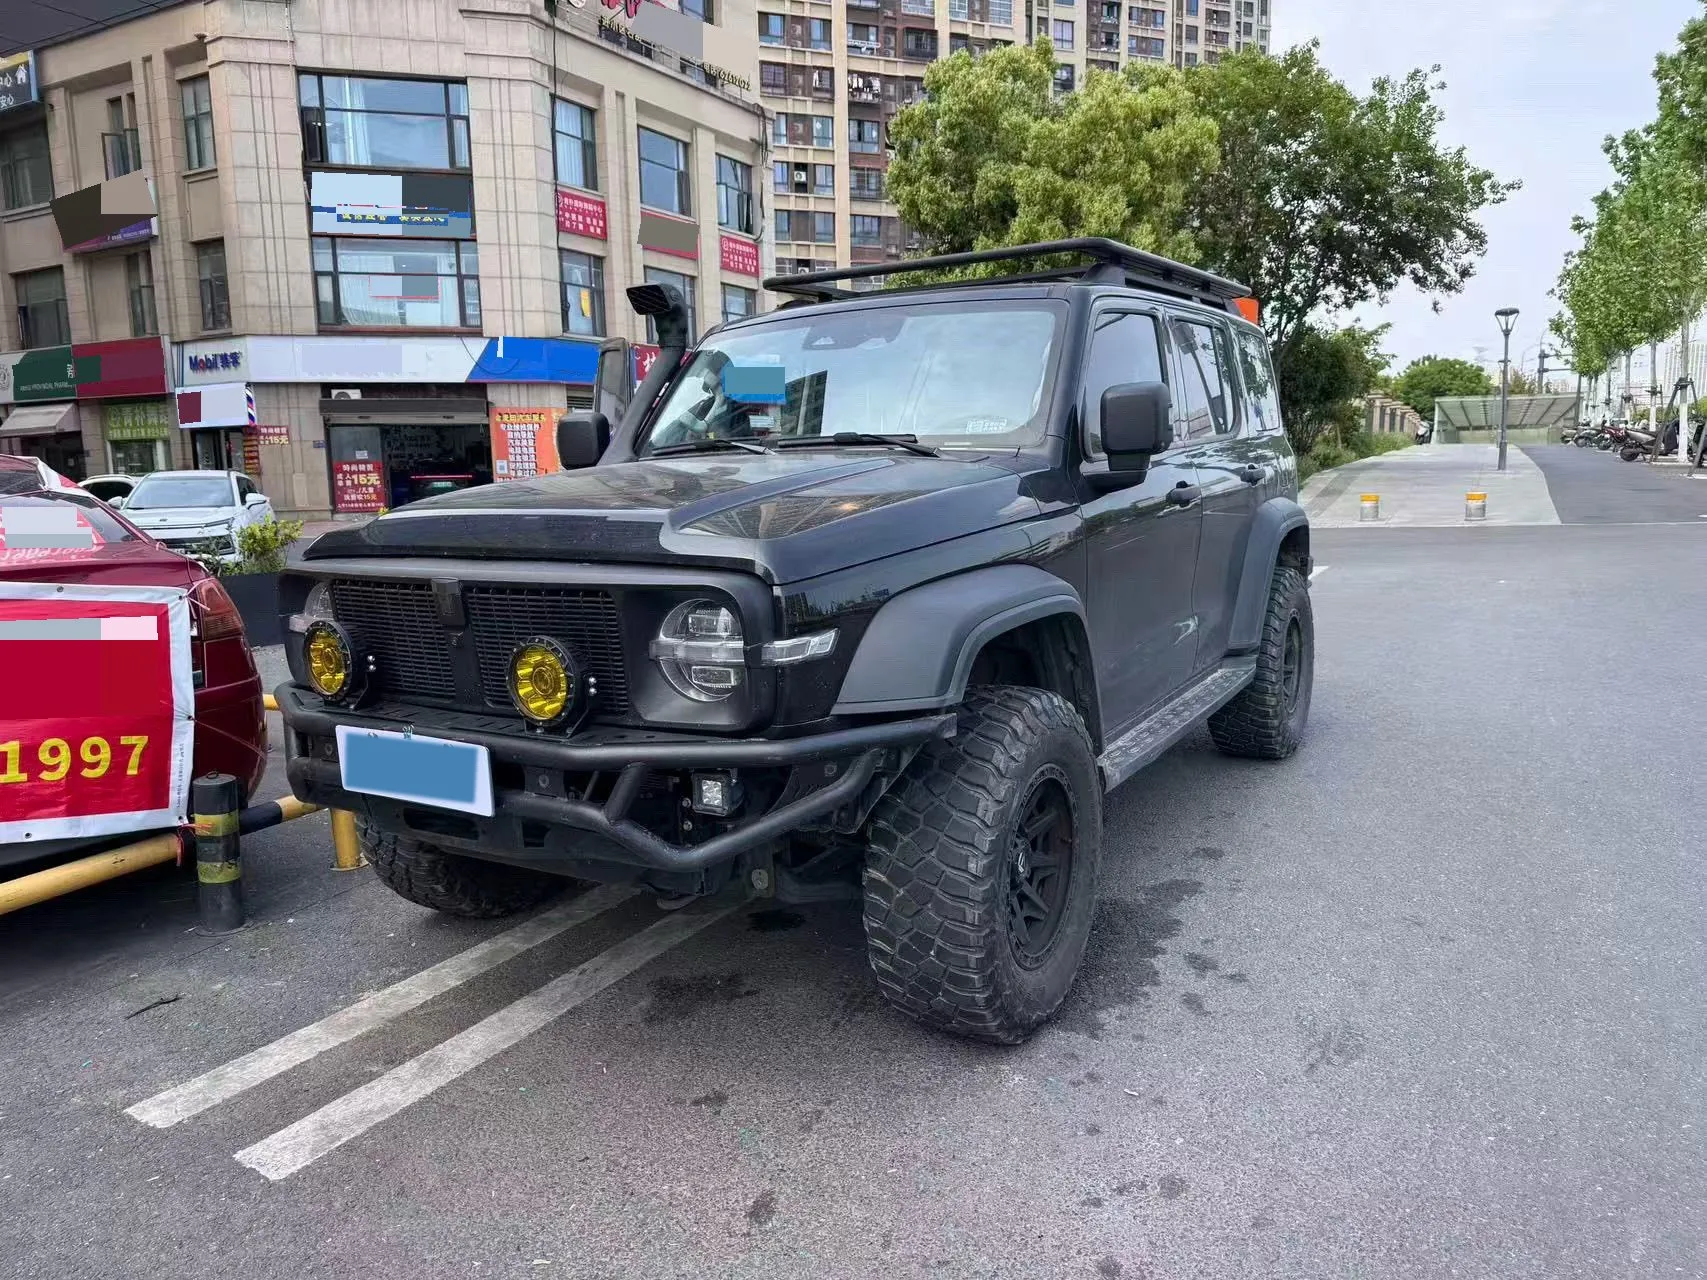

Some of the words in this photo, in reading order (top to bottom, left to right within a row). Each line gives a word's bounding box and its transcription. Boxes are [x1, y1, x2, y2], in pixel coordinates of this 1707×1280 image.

[189, 354, 219, 370] Mobil
[352, 473, 381, 485] 15元
[0, 735, 149, 783] 1997
